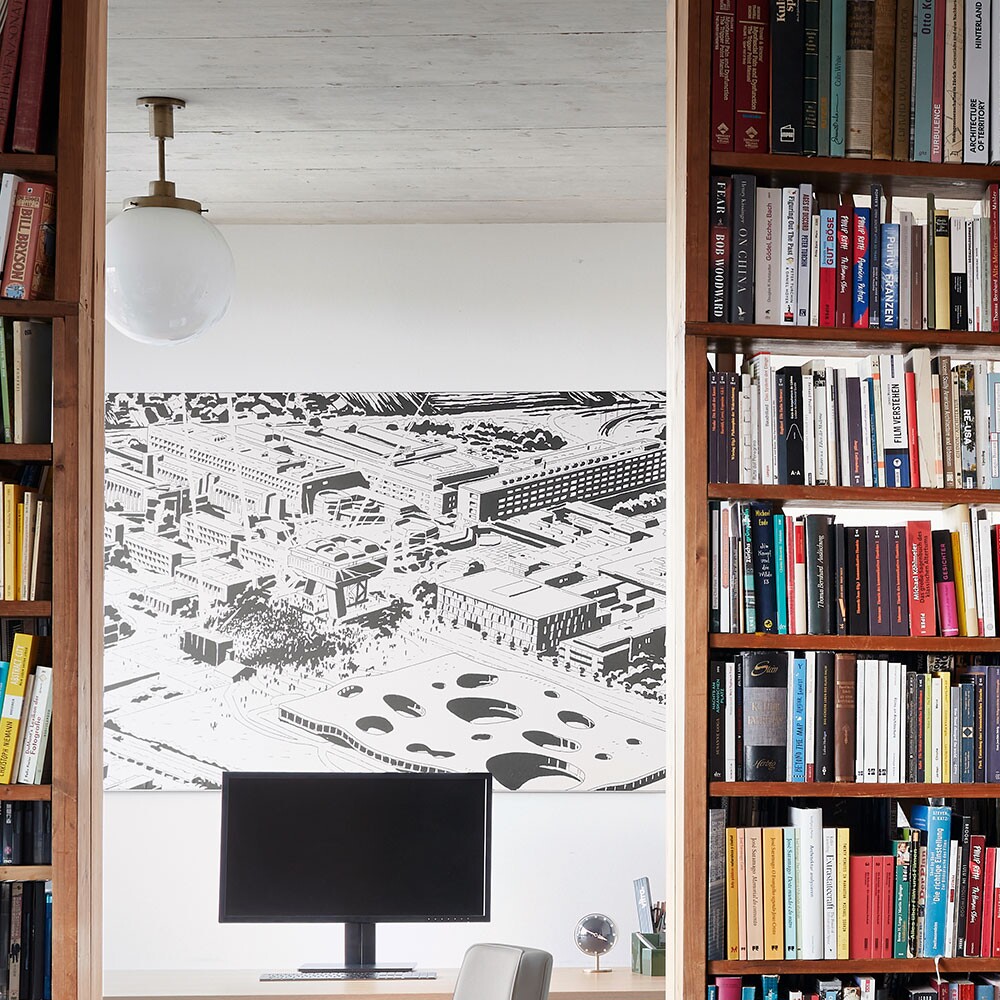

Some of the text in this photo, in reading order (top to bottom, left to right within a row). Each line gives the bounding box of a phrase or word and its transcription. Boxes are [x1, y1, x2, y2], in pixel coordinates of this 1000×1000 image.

[933, 104, 941, 155] TURBULENCE
[969, 99, 977, 153] ARCHITECTURE
[978, 138, 985, 151] OF
[716, 182, 726, 214] FEAR
[10, 207, 33, 282] BILL BRYSON
[765, 219, 773, 241] Escher,
[765, 242, 773, 261] Gödel,
[824, 217, 834, 266] GUT BÖSE
[714, 234, 725, 317] BOB WOODWARD
[738, 228, 748, 293] ON CHINA
[891, 383, 902, 444] FILM VERSTEHEN
[963, 409, 972, 445] RE-USA
[940, 543, 949, 581] GESICHTER
[31, 716, 42, 755] Fotografie
[826, 854, 835, 909] Extrastatecraft
[933, 828, 943, 902] Die richtige Einstellung
